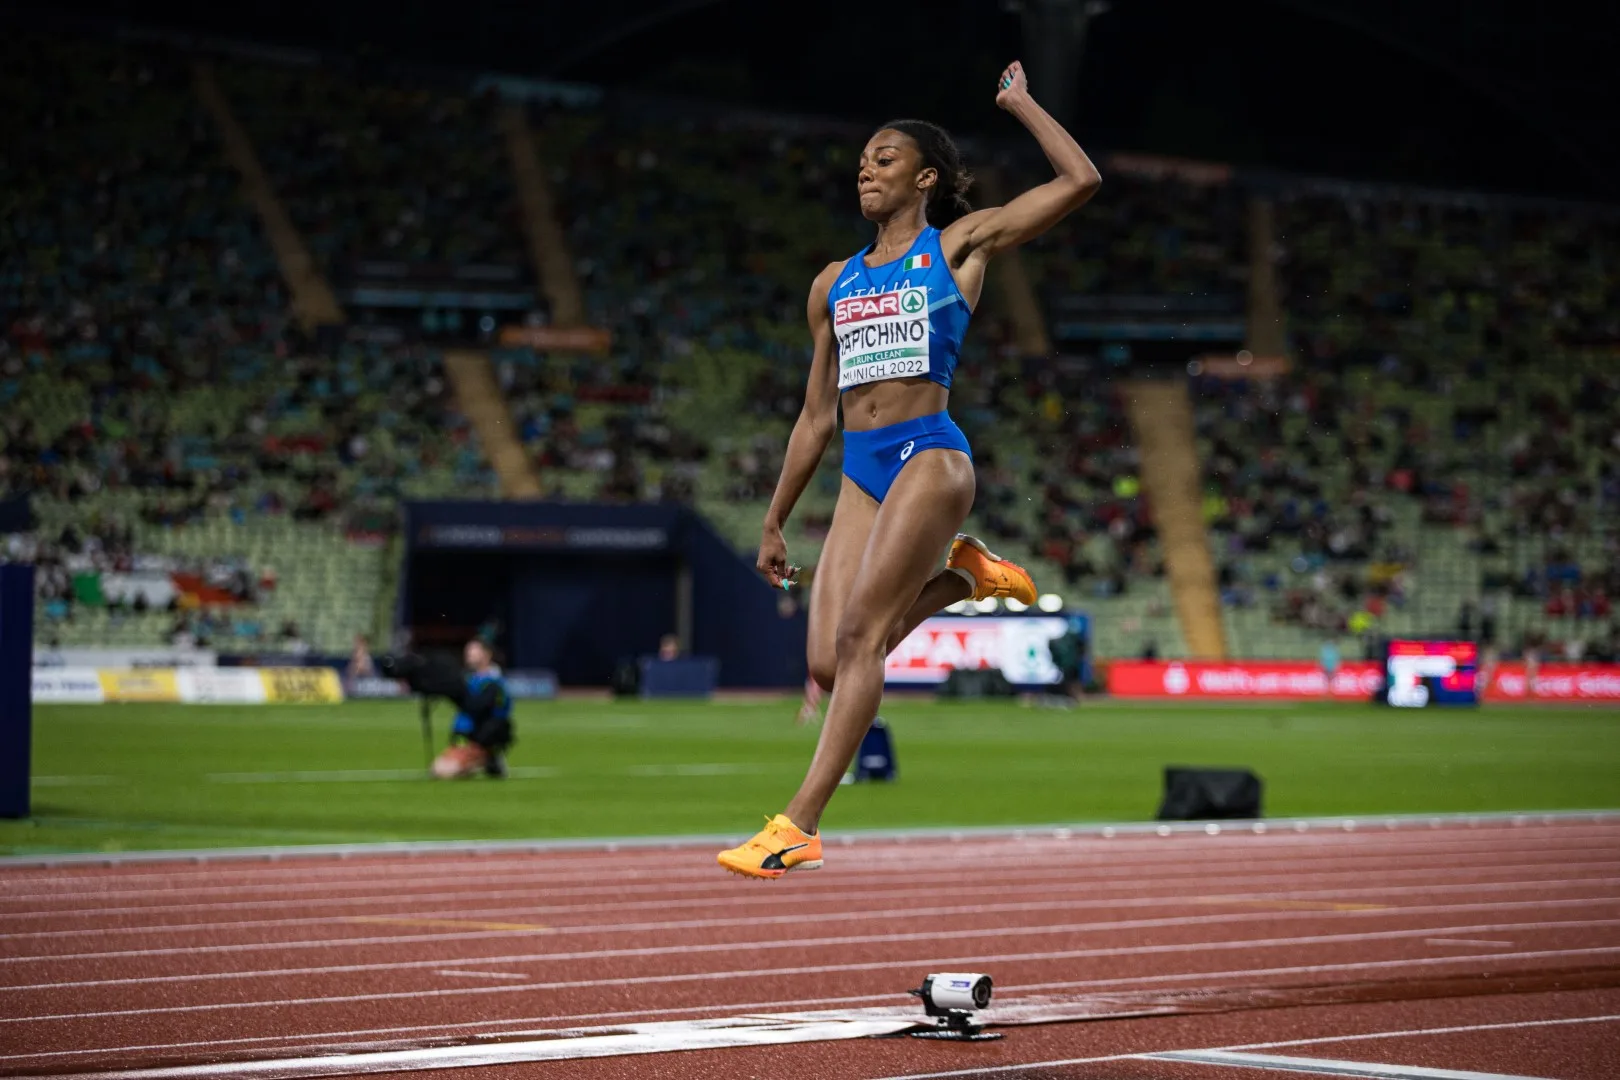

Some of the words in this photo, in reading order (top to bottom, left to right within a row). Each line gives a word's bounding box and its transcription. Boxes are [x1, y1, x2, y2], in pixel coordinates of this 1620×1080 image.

[836, 296, 899, 322] SPAR
[857, 353, 874, 364] RUN
[875, 350, 902, 361] CLEAN
[842, 364, 885, 385] MUNICH
[889, 360, 923, 375] 2022
